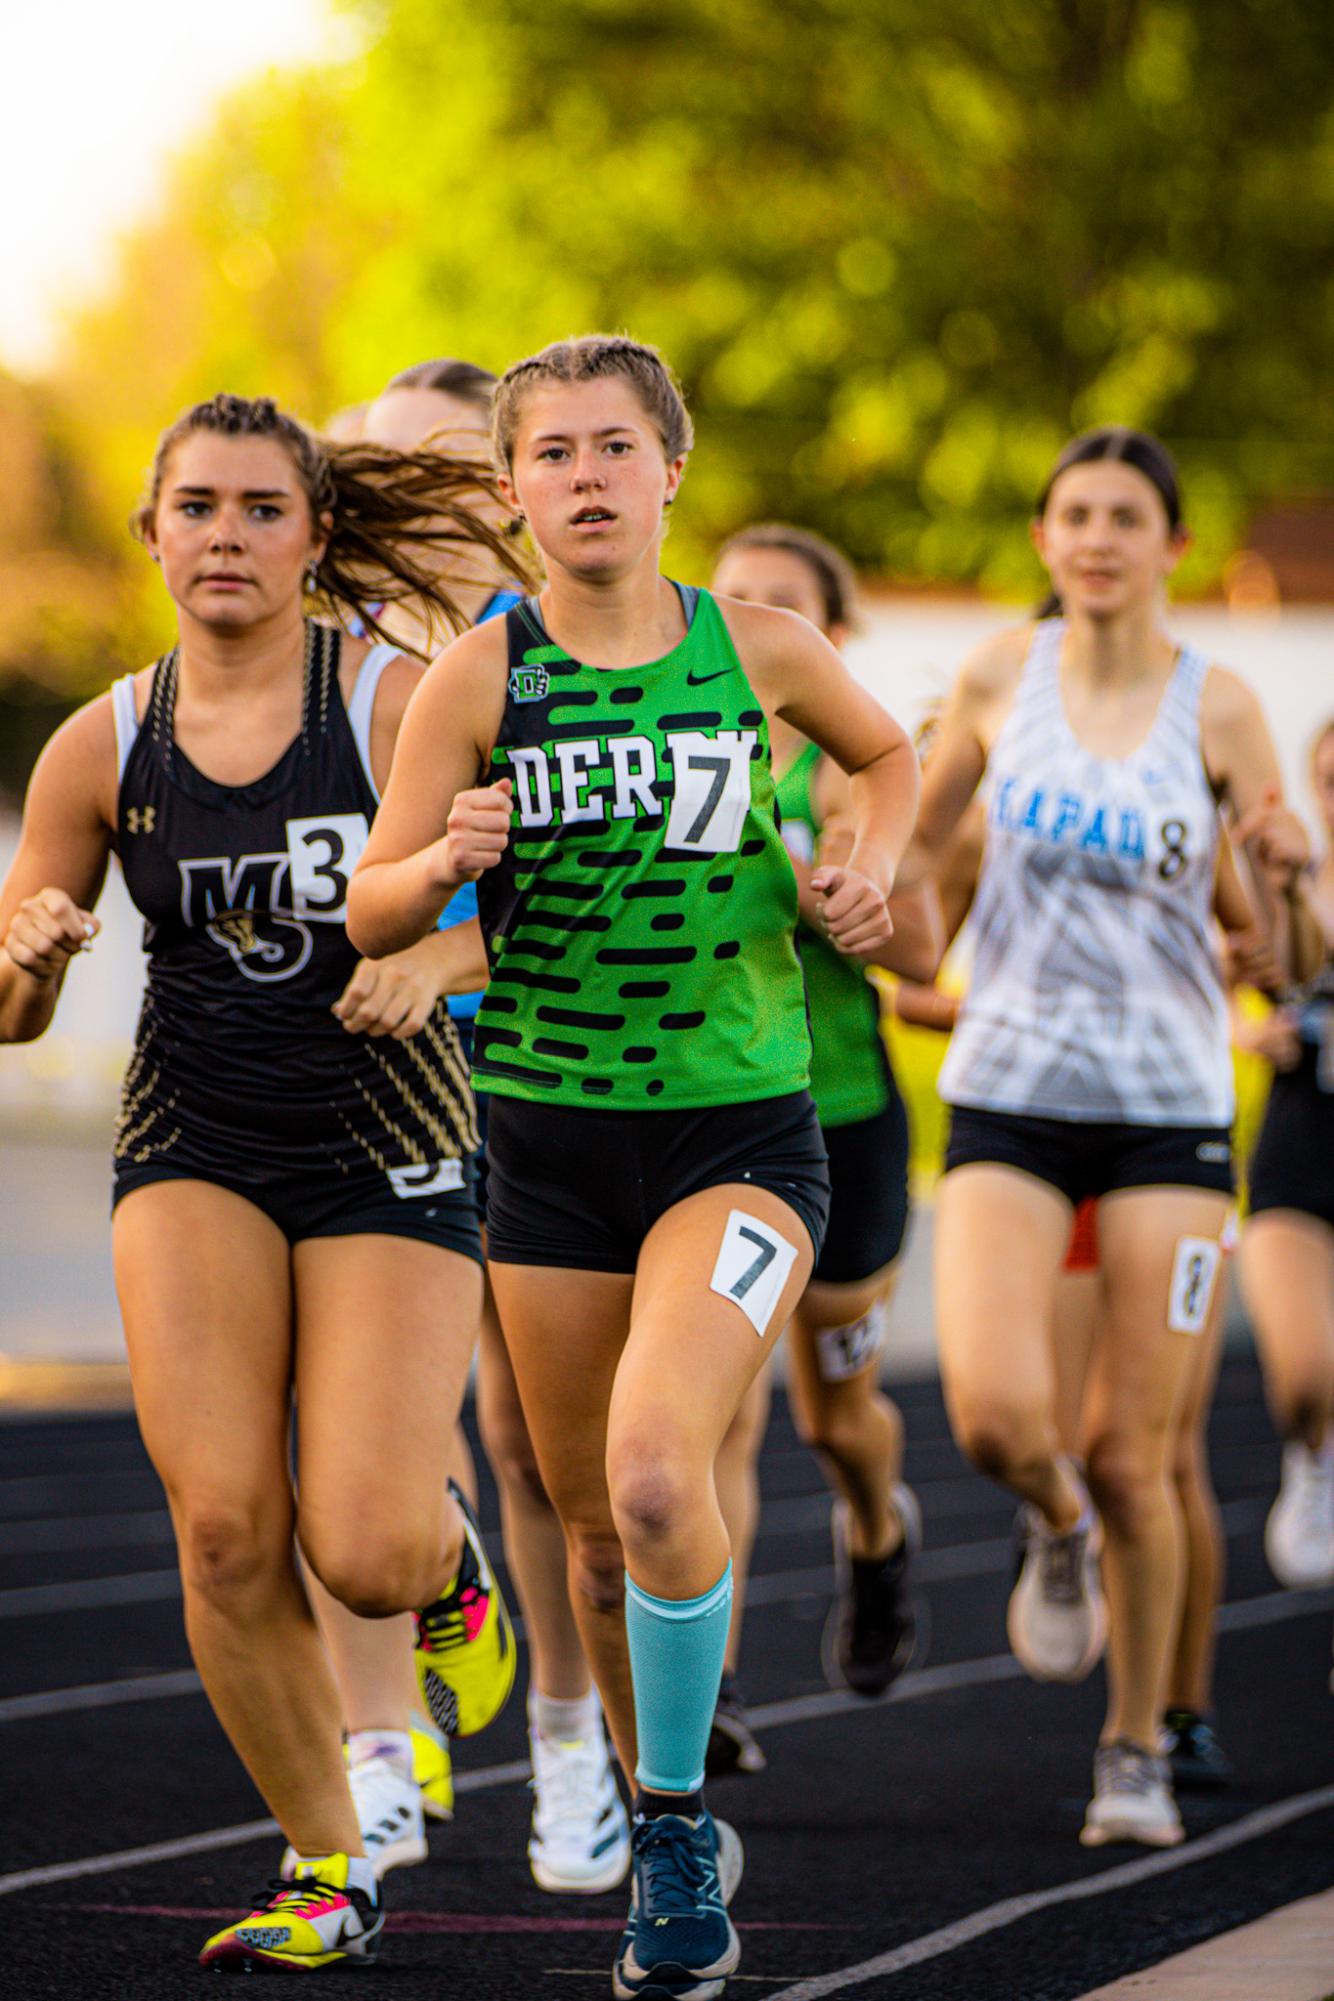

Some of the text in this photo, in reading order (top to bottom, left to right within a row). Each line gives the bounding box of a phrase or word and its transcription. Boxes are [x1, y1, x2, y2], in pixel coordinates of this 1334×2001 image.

[506, 729, 758, 828] DER
[684, 755, 731, 844] 7
[302, 828, 349, 913] 3
[1158, 819, 1189, 881] 8
[730, 1225, 778, 1300] 7
